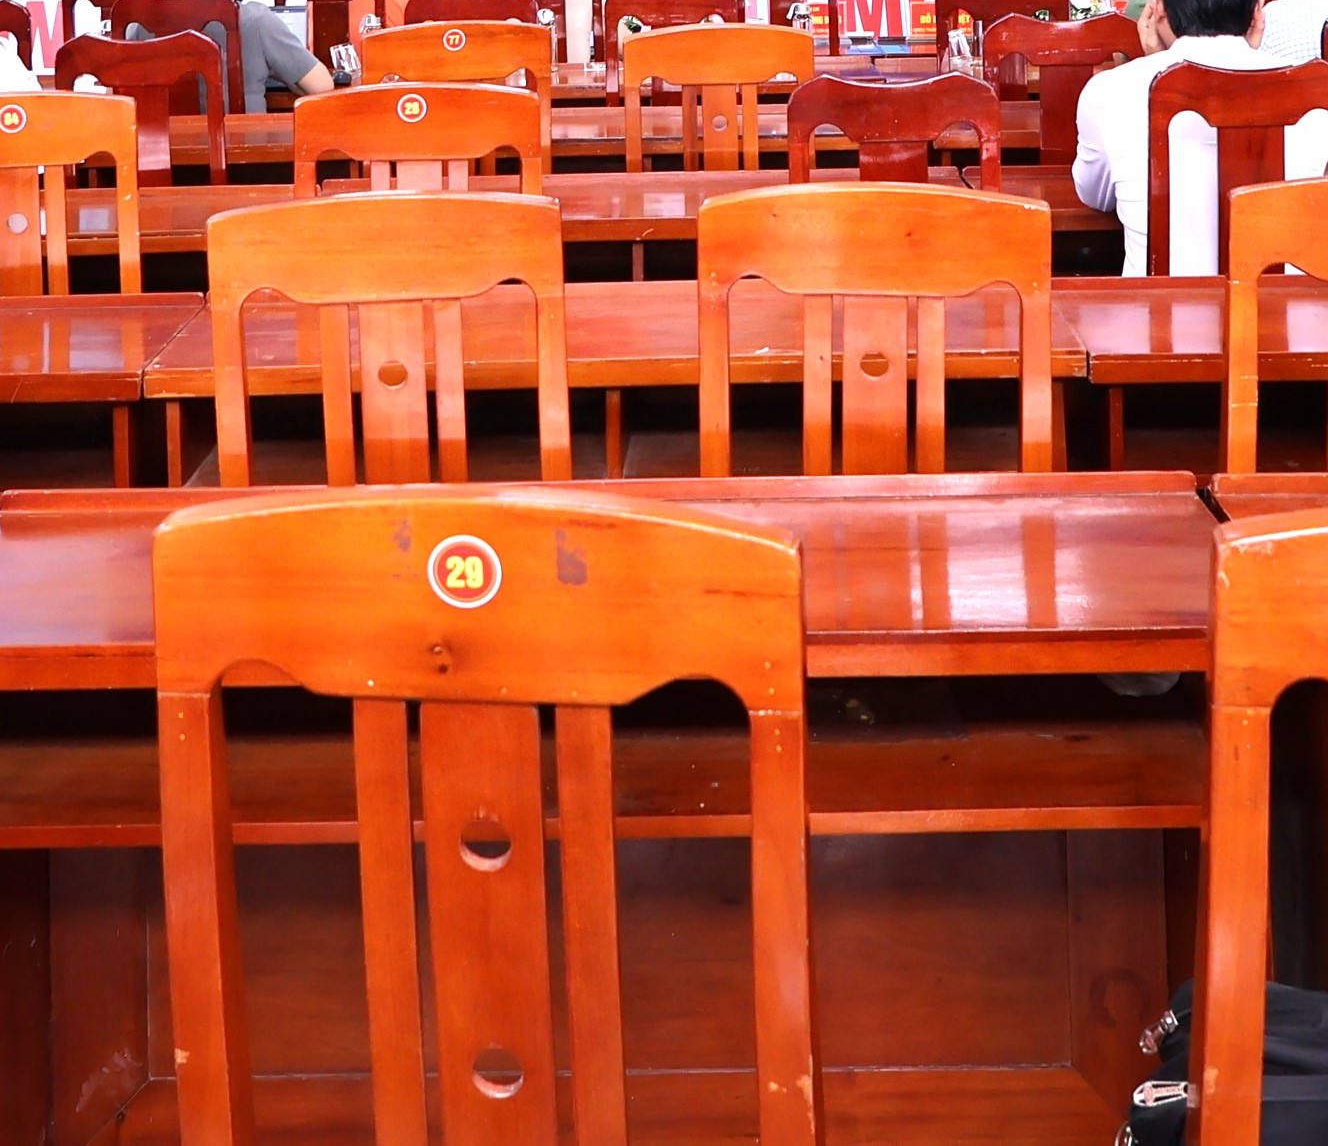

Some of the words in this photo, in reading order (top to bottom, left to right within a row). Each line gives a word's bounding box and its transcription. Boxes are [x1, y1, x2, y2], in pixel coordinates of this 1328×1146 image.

[448, 35, 460, 44] 77
[3, 112, 19, 126] 84
[446, 556, 483, 587] 29
